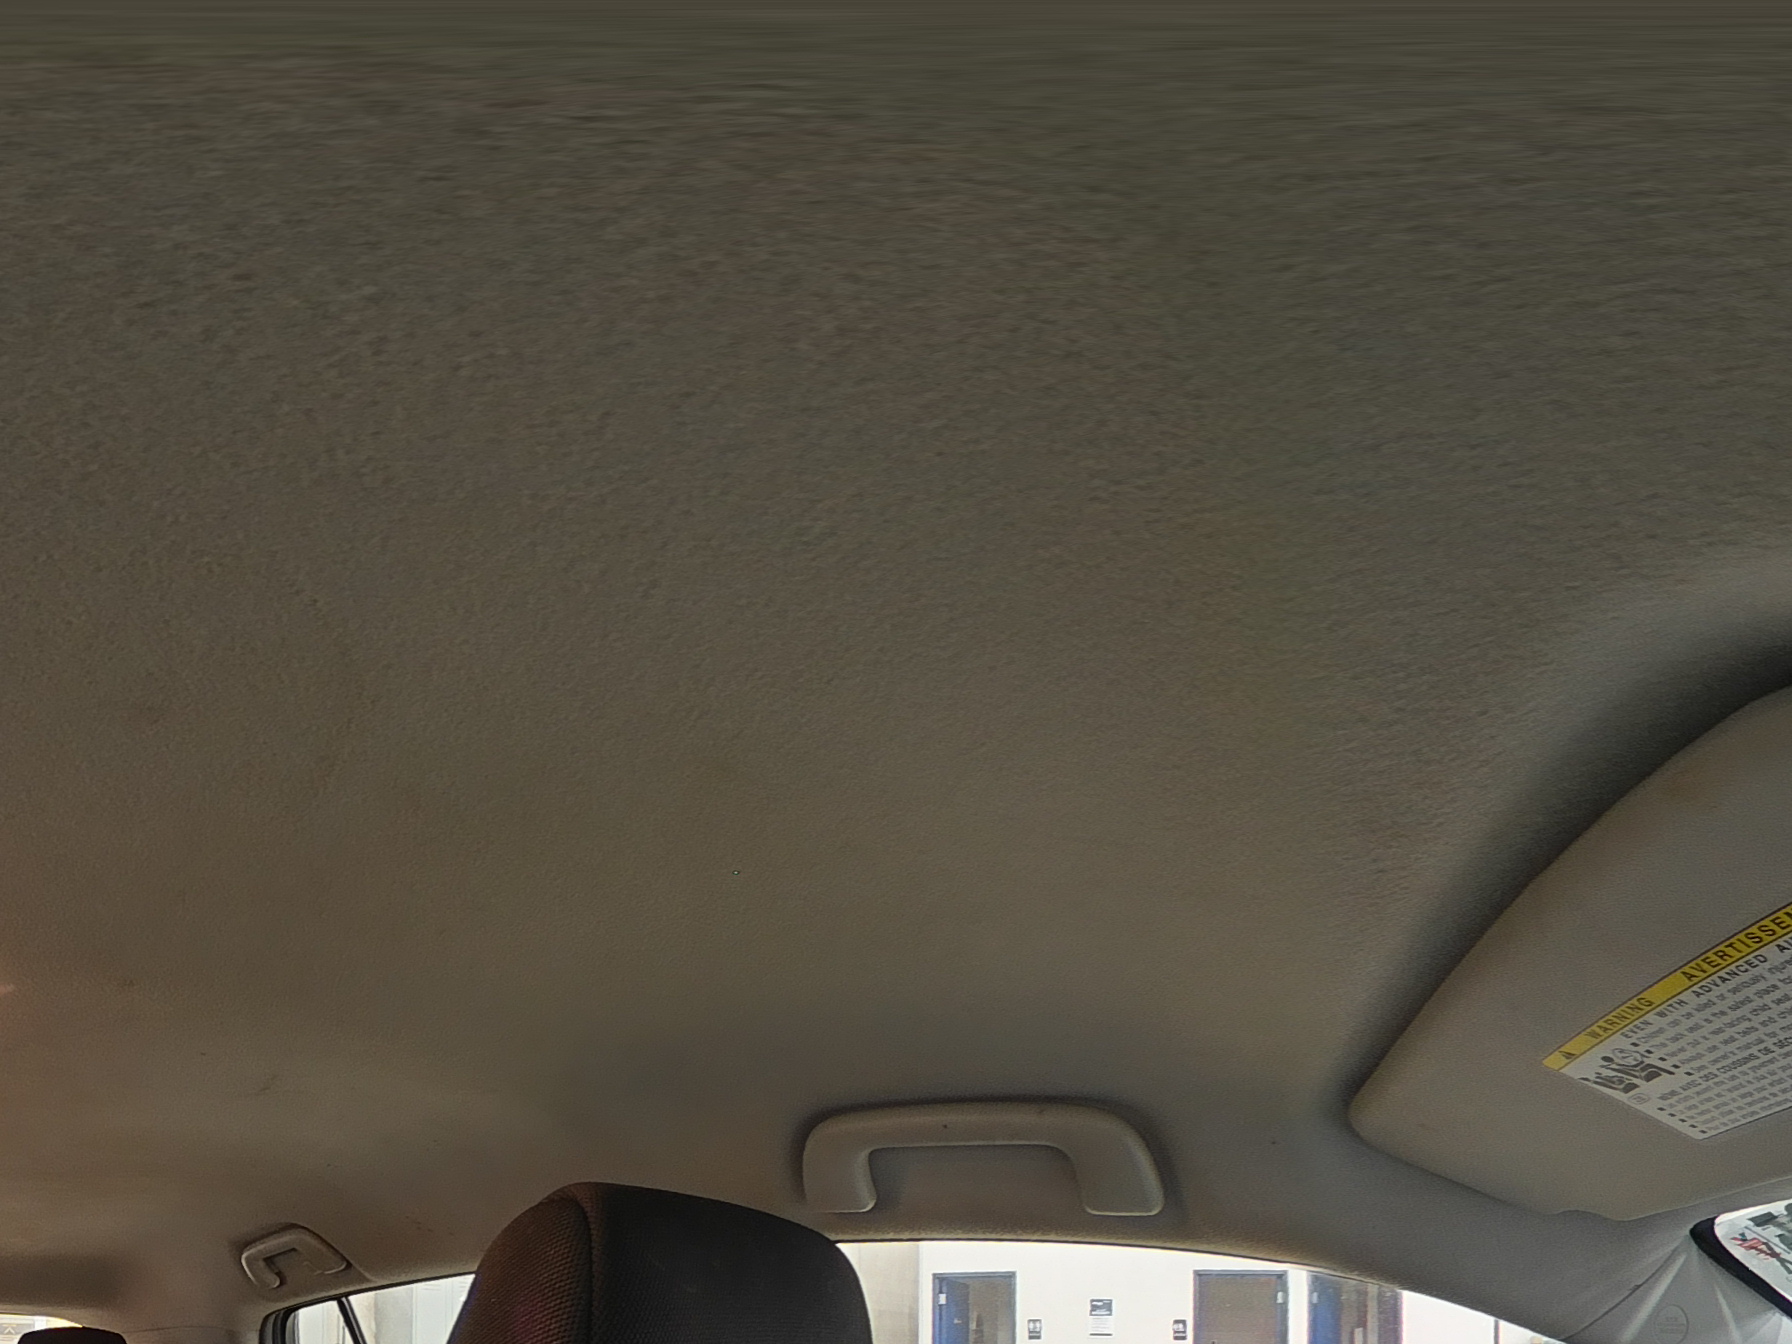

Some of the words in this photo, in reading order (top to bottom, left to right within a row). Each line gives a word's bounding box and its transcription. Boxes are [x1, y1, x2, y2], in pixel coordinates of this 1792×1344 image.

[1584, 996, 1656, 1040] WARNING
[1621, 1019, 1653, 1038] EVEN
[1655, 998, 1688, 1018] WITH
[1692, 953, 1769, 997] ADVANCED
